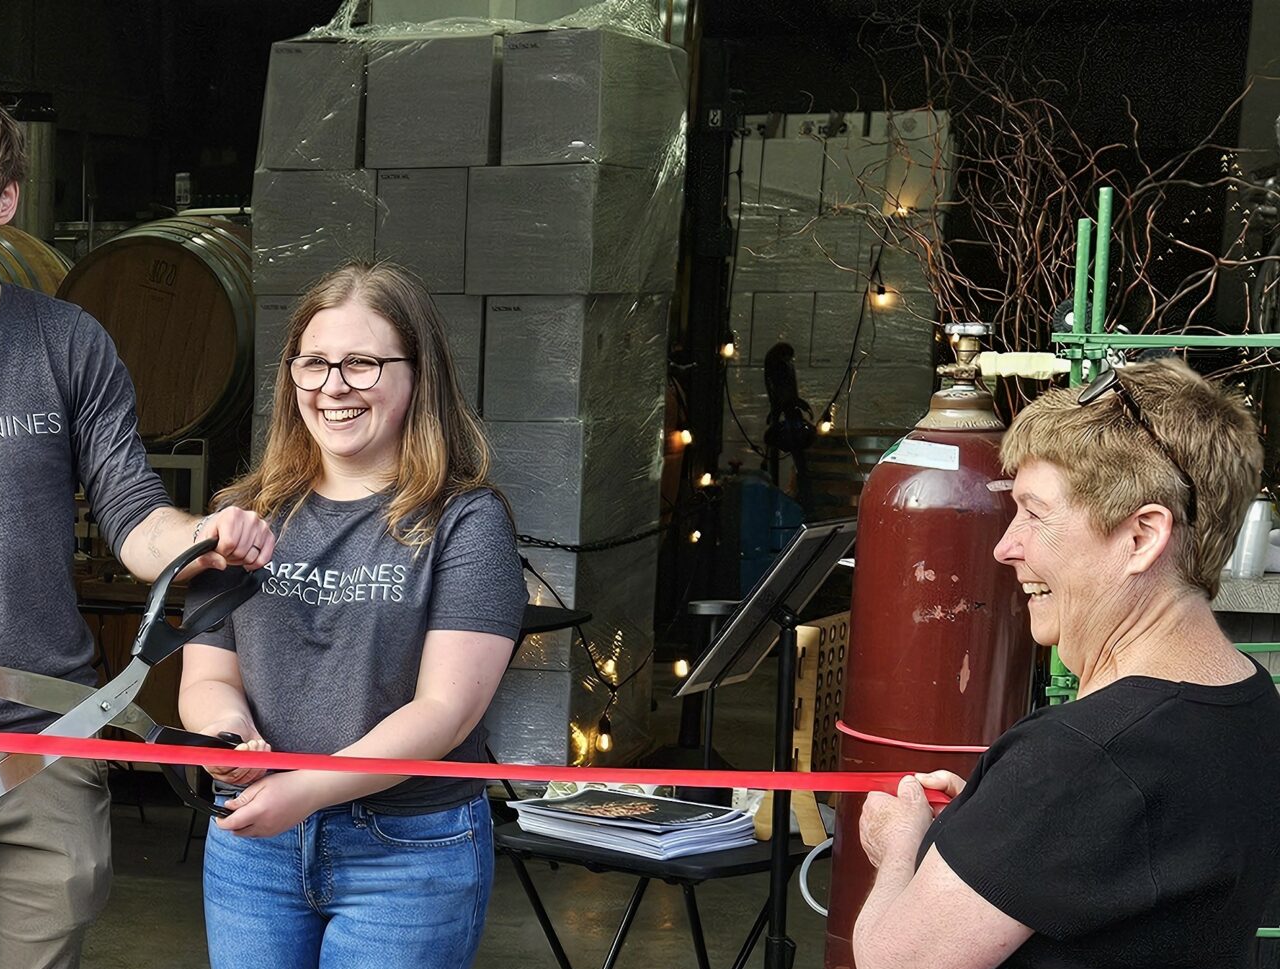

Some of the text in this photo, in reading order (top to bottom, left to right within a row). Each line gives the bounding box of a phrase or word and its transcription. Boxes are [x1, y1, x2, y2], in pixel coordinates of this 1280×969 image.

[263, 561, 407, 589] ARZAE WINES
[261, 576, 404, 606] SSACHUSETTS
